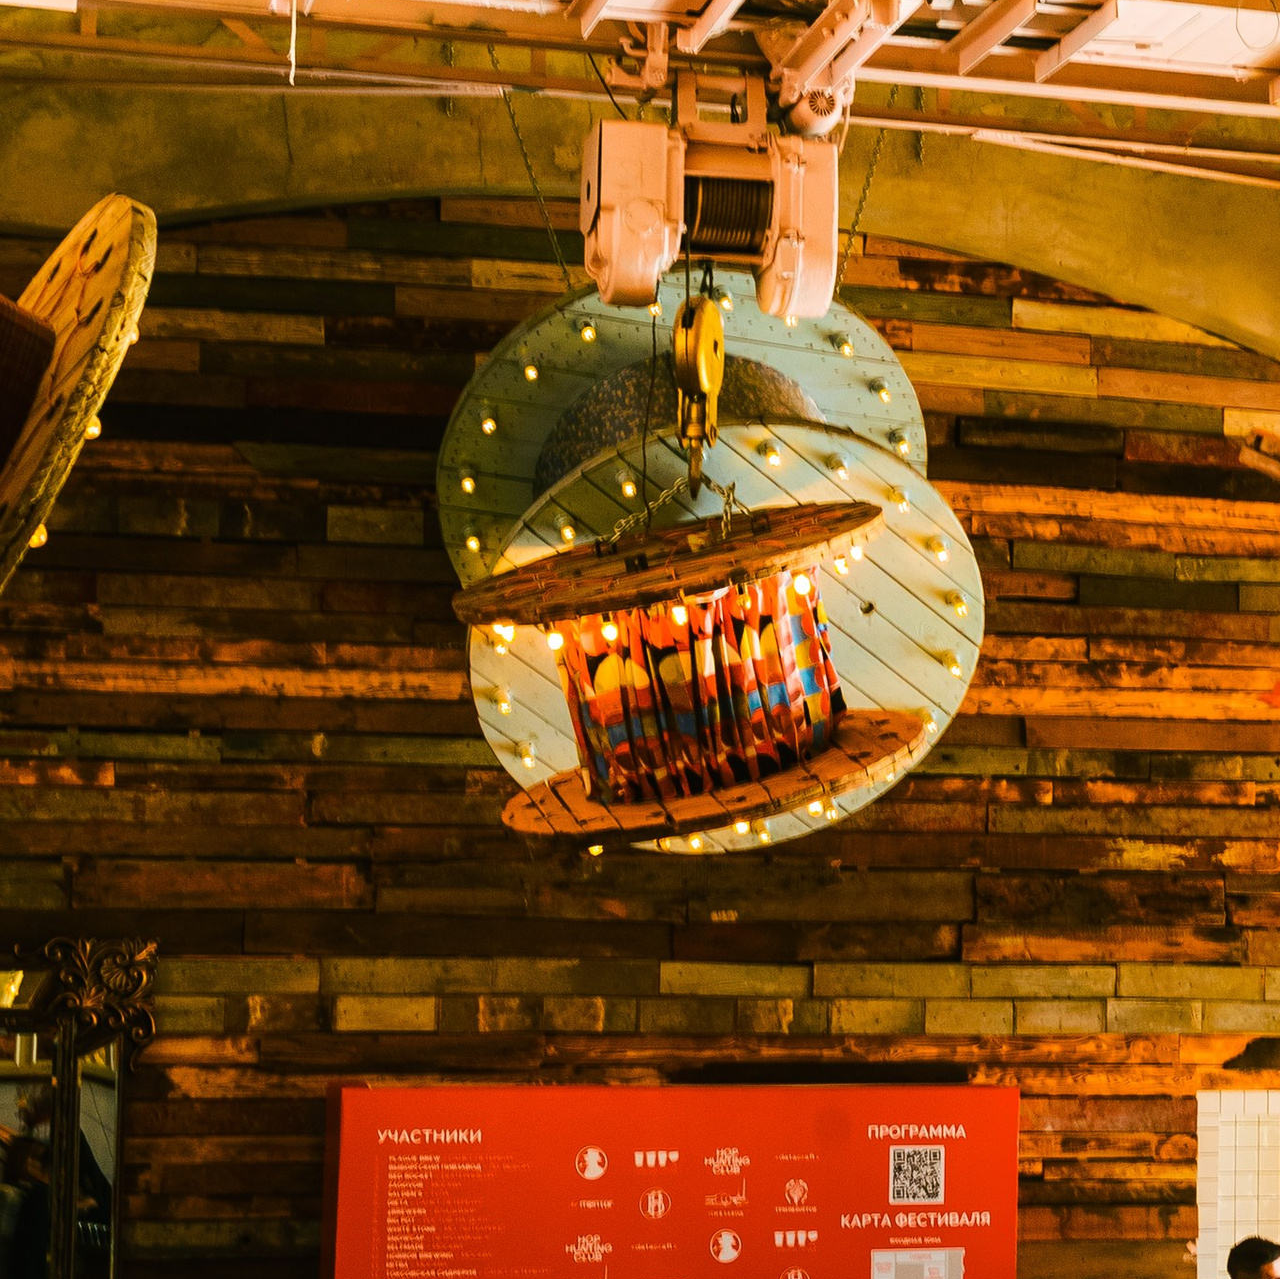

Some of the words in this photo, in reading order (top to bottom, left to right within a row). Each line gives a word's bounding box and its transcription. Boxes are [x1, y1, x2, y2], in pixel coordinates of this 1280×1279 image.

[377, 1128, 482, 1144] УЧАСТНИКИ
[868, 1124, 967, 1140] ПРОГРАММА
[841, 1213, 892, 1229] КАРТА
[895, 1211, 991, 1228] ФЕСТИВАЛЯ
